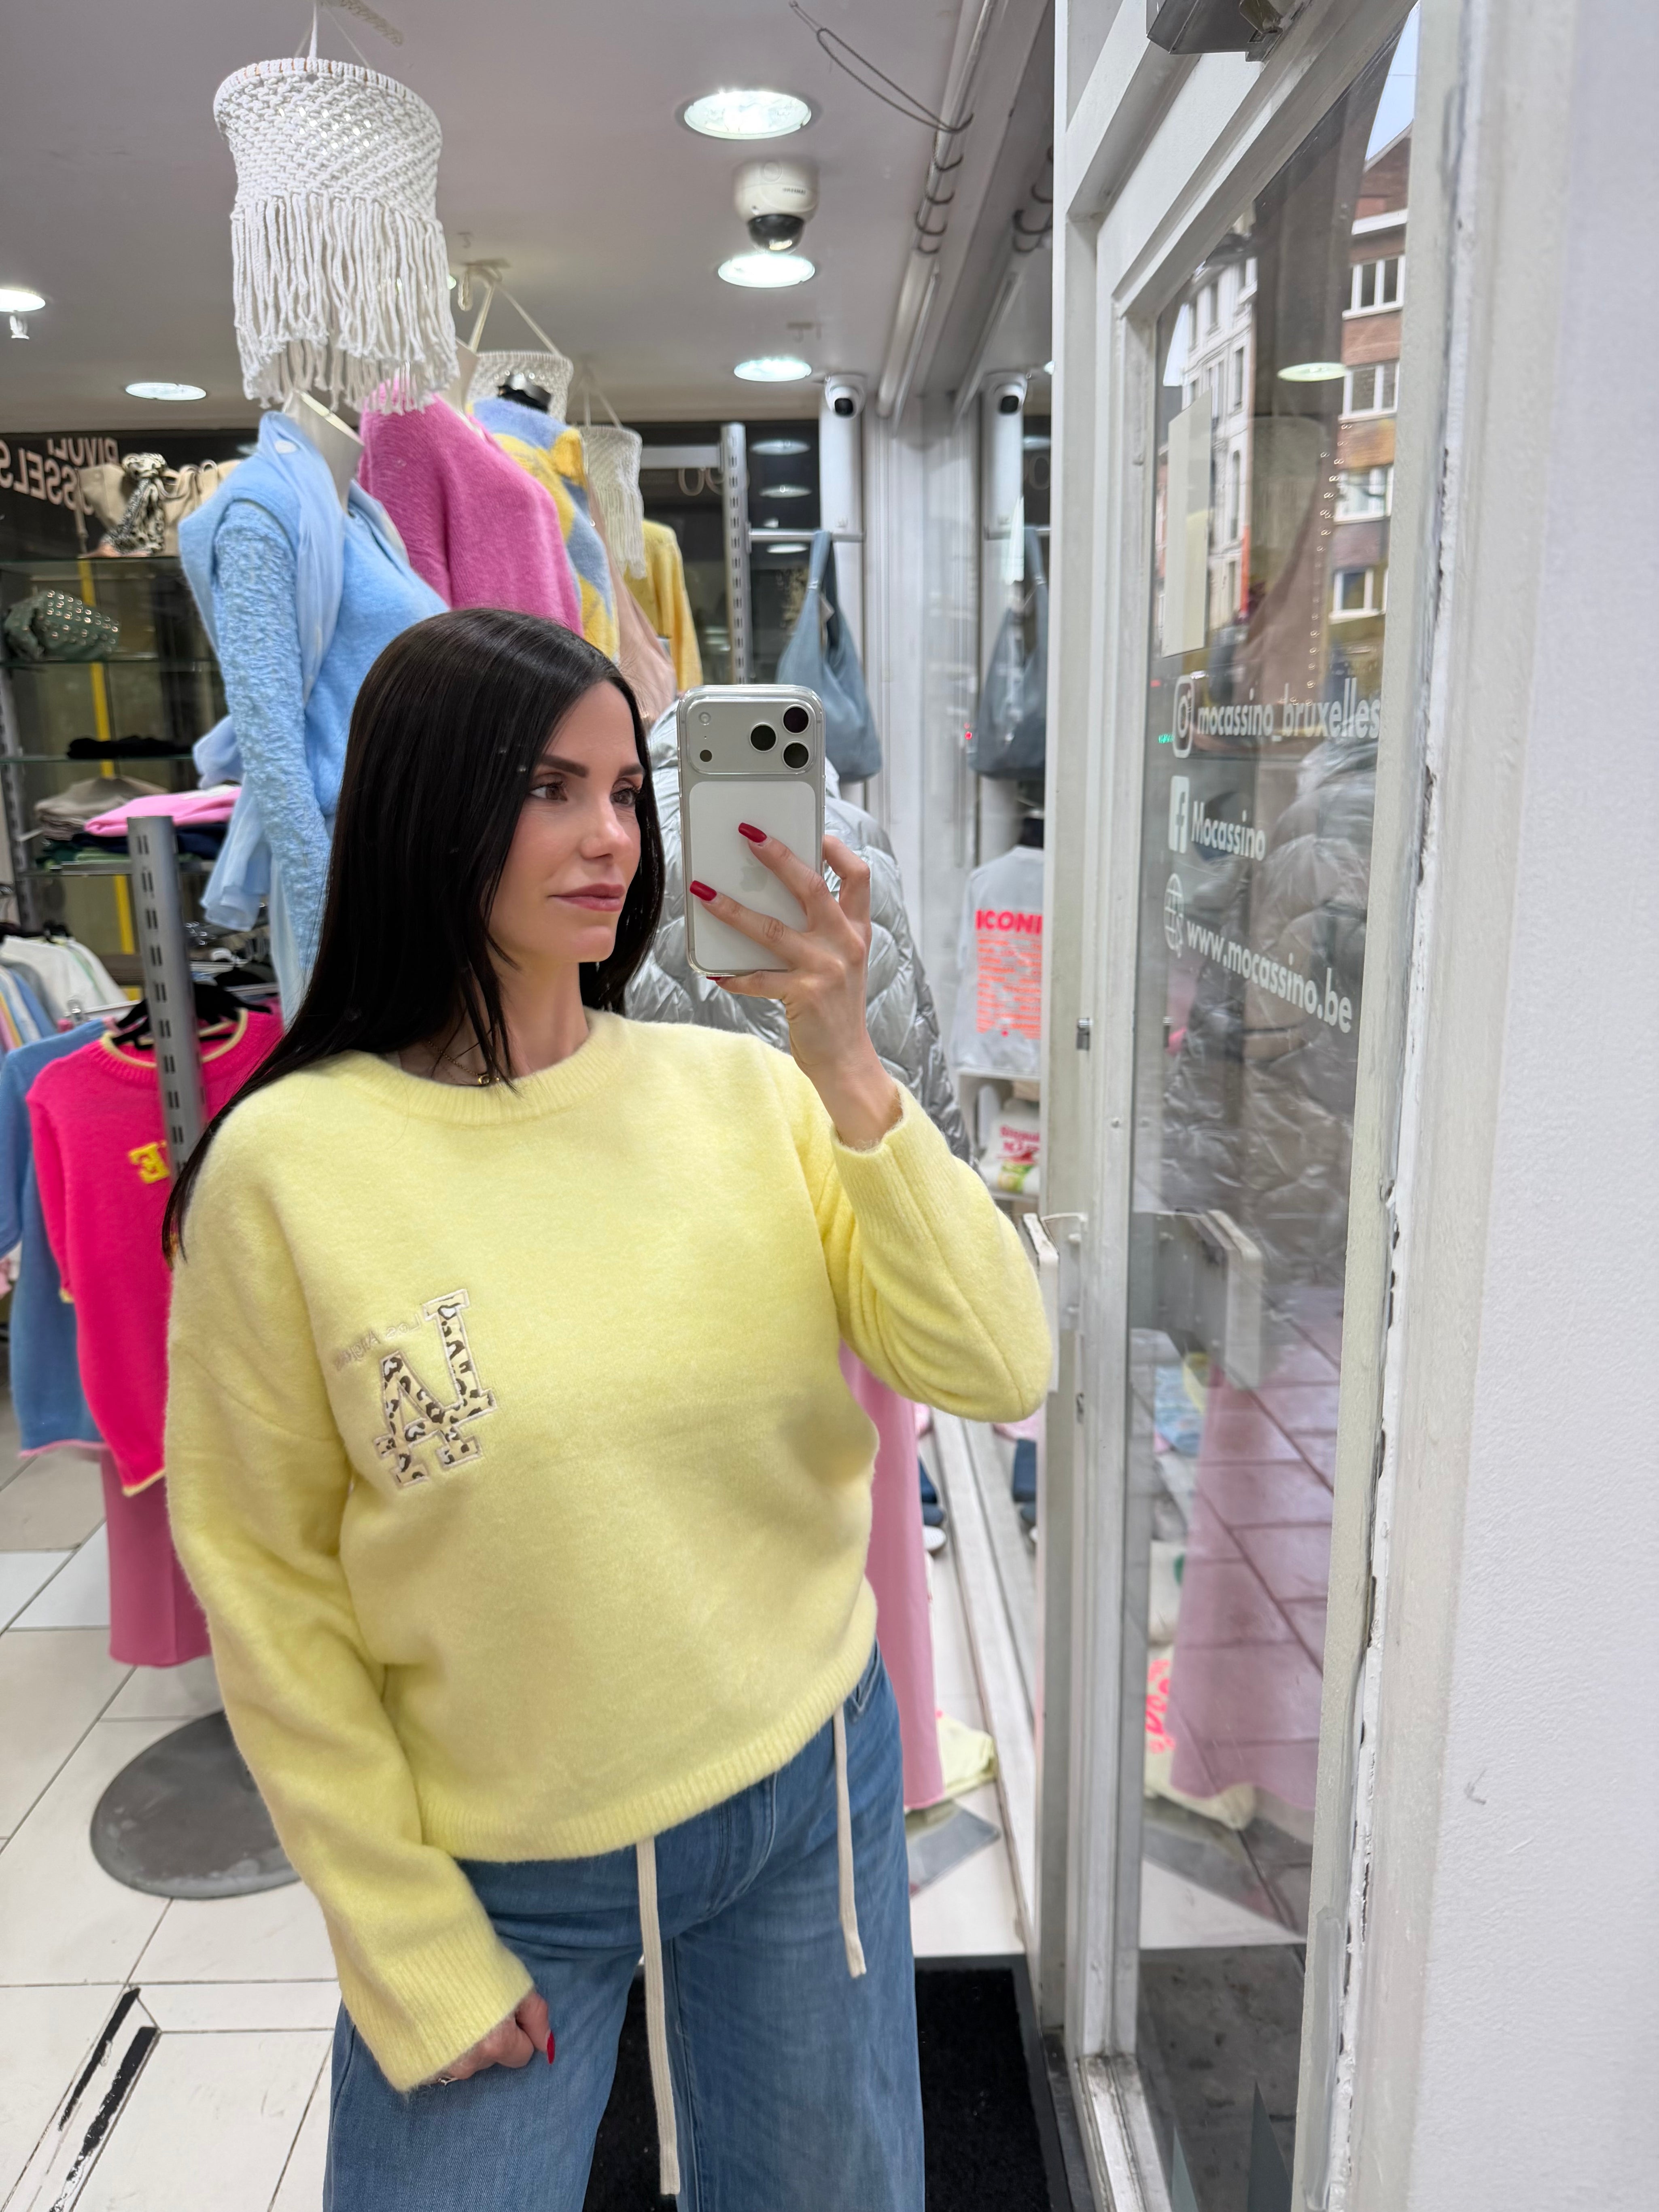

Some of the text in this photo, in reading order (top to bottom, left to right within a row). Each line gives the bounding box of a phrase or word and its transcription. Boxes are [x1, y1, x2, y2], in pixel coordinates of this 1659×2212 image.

[1197, 678, 1380, 742] mocassino_bruxelles
[1191, 800, 1266, 861] Mocassino
[1186, 919, 1352, 1033] www.mocassino.be
